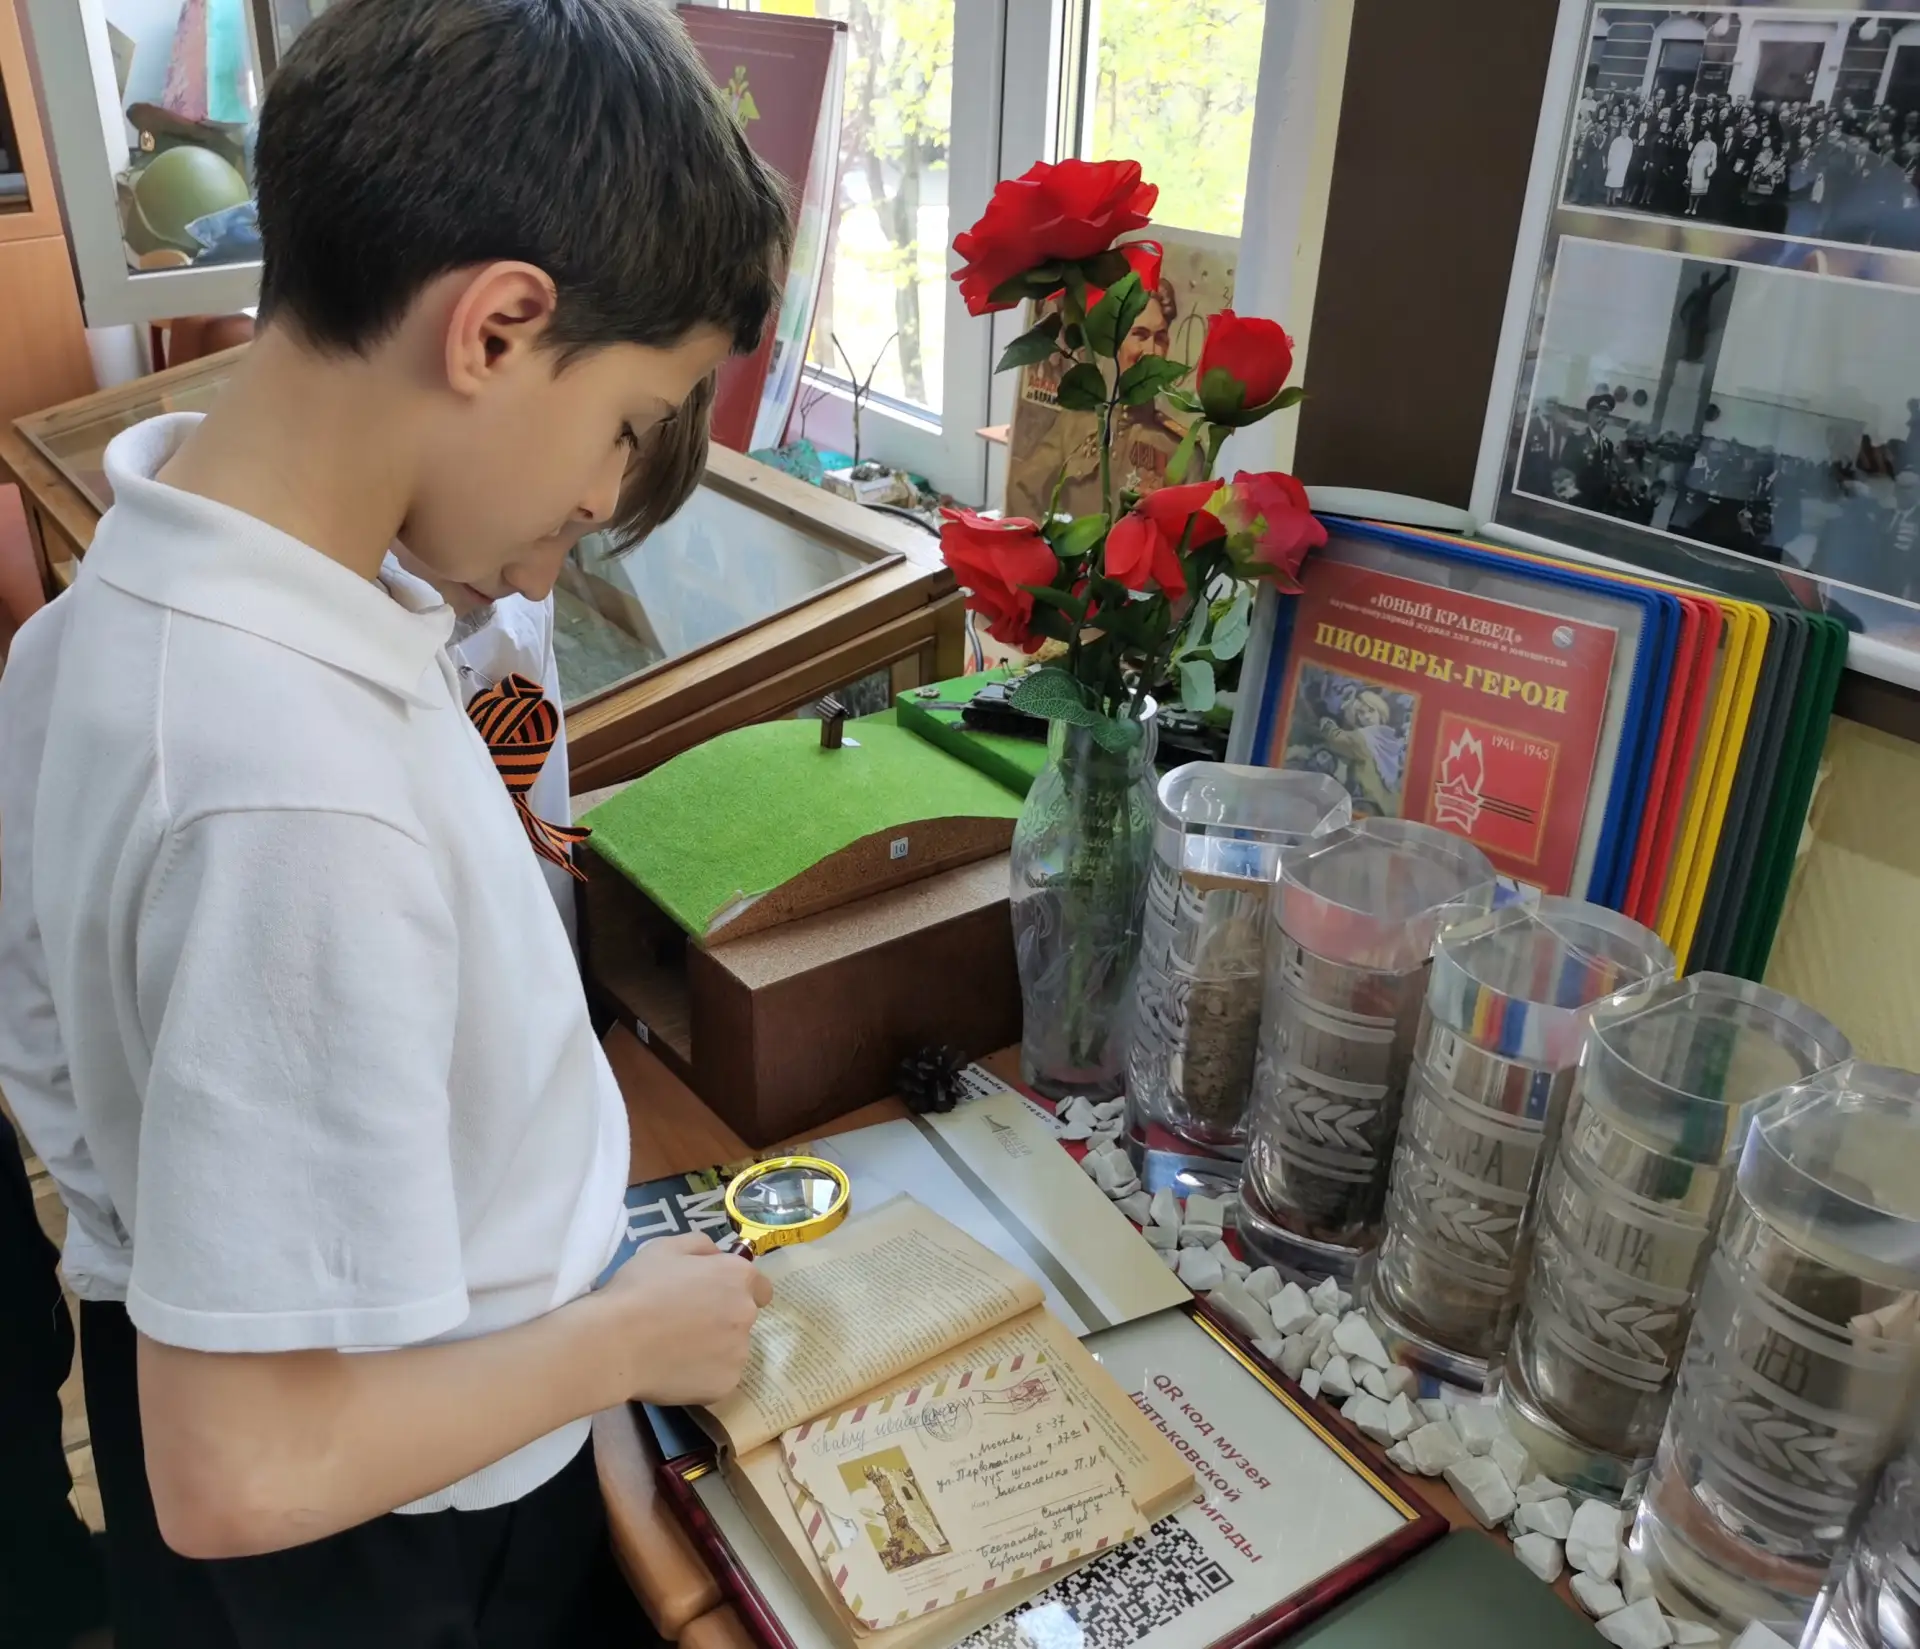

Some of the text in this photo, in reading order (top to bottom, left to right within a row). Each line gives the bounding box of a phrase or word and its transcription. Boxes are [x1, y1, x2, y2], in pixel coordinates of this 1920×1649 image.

[1370, 592, 1523, 645] «ЮНЫЙ КРАЕВЕД»
[1315, 622, 1569, 714] ПИОНЕРЫ-ГЕРОИ
[895, 842, 906, 855] 10
[1128, 1390, 1243, 1503] Дятьковской
[1153, 1374, 1272, 1490] QR код музея
